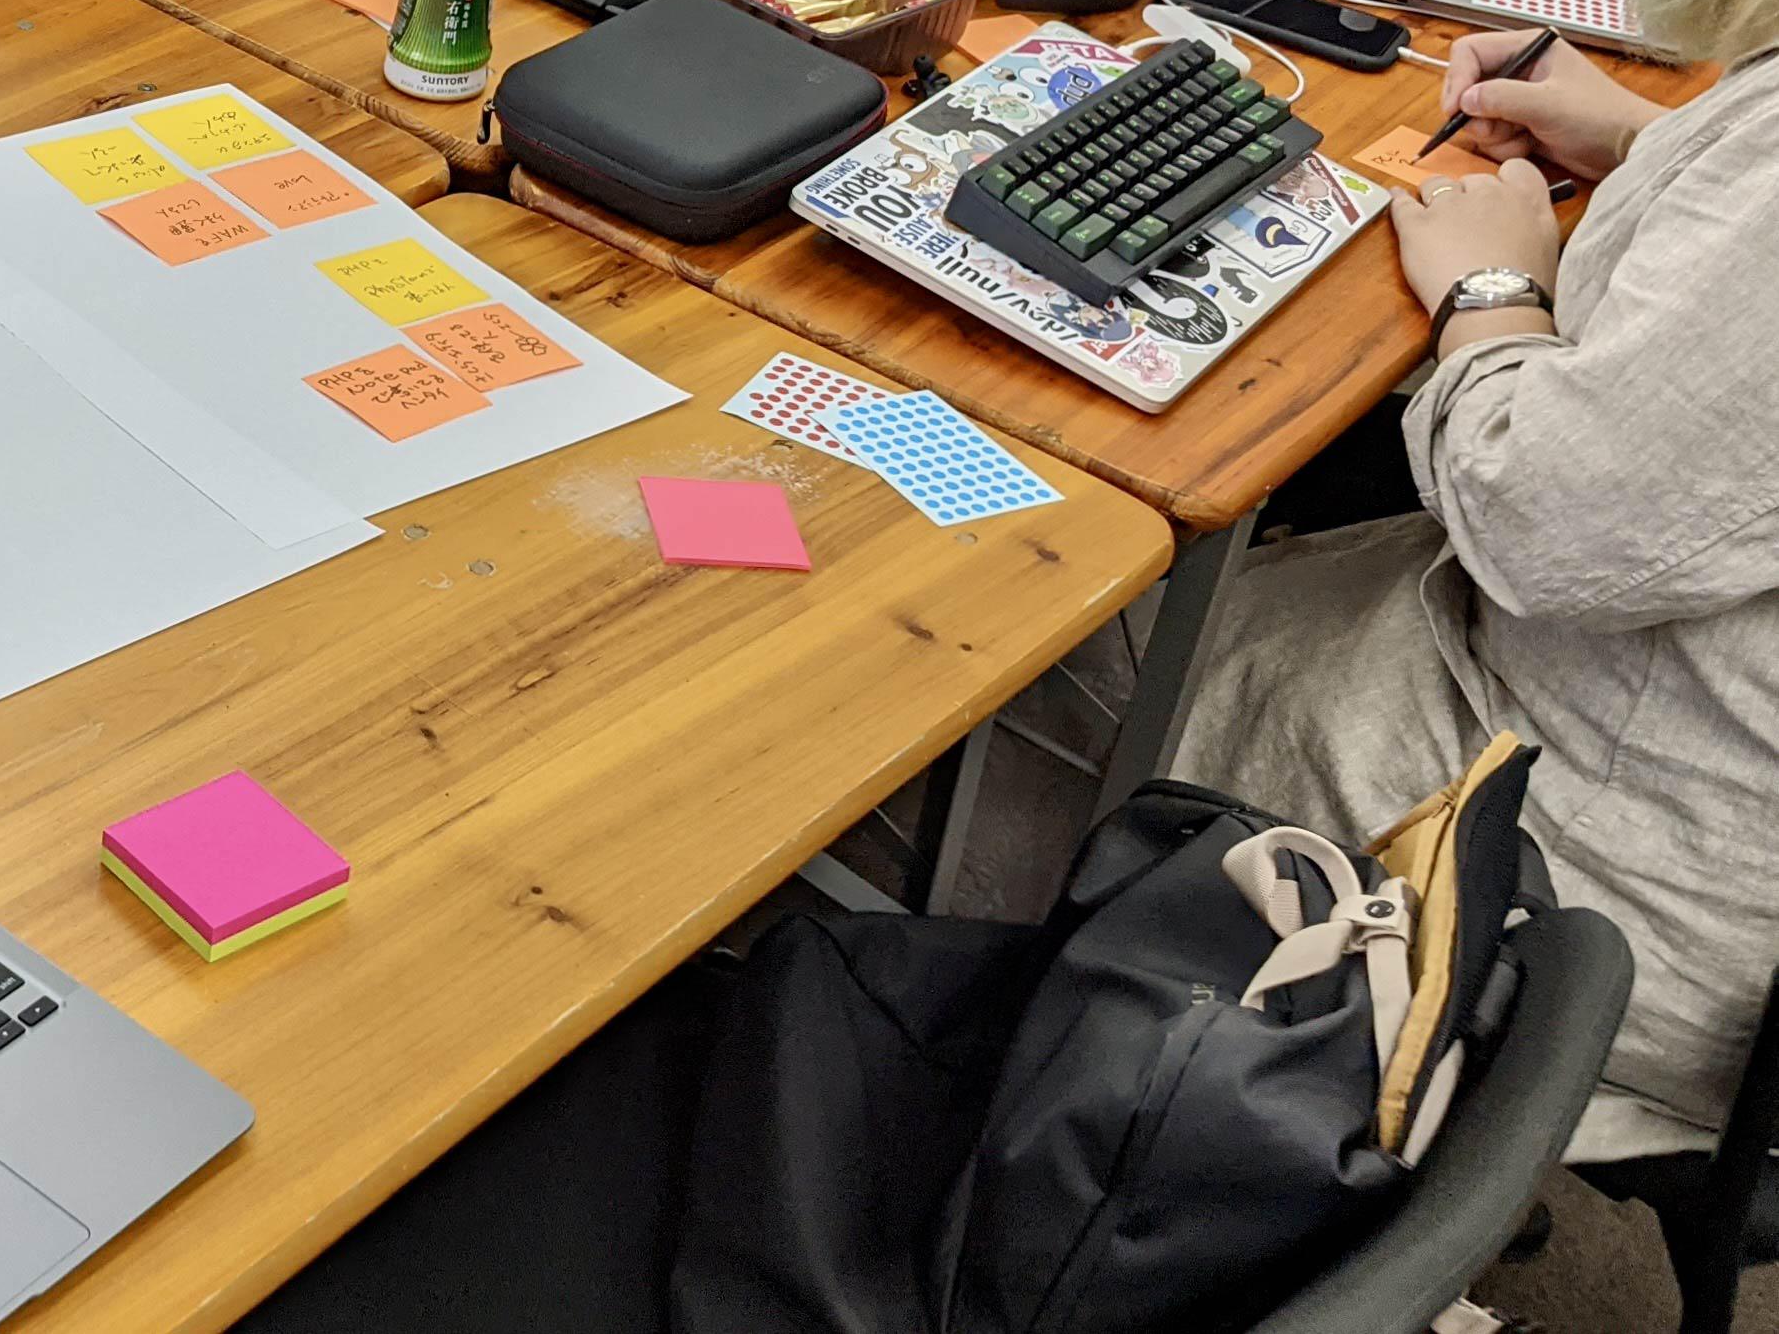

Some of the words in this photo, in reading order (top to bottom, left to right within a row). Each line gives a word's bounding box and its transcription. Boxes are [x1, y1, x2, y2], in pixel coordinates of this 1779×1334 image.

[805, 158, 861, 194] SOMETHING
[823, 166, 889, 209] BROKE
[854, 185, 920, 233] YOU
[936, 256, 1081, 341] /dev/null
[318, 366, 375, 389] PHPを
